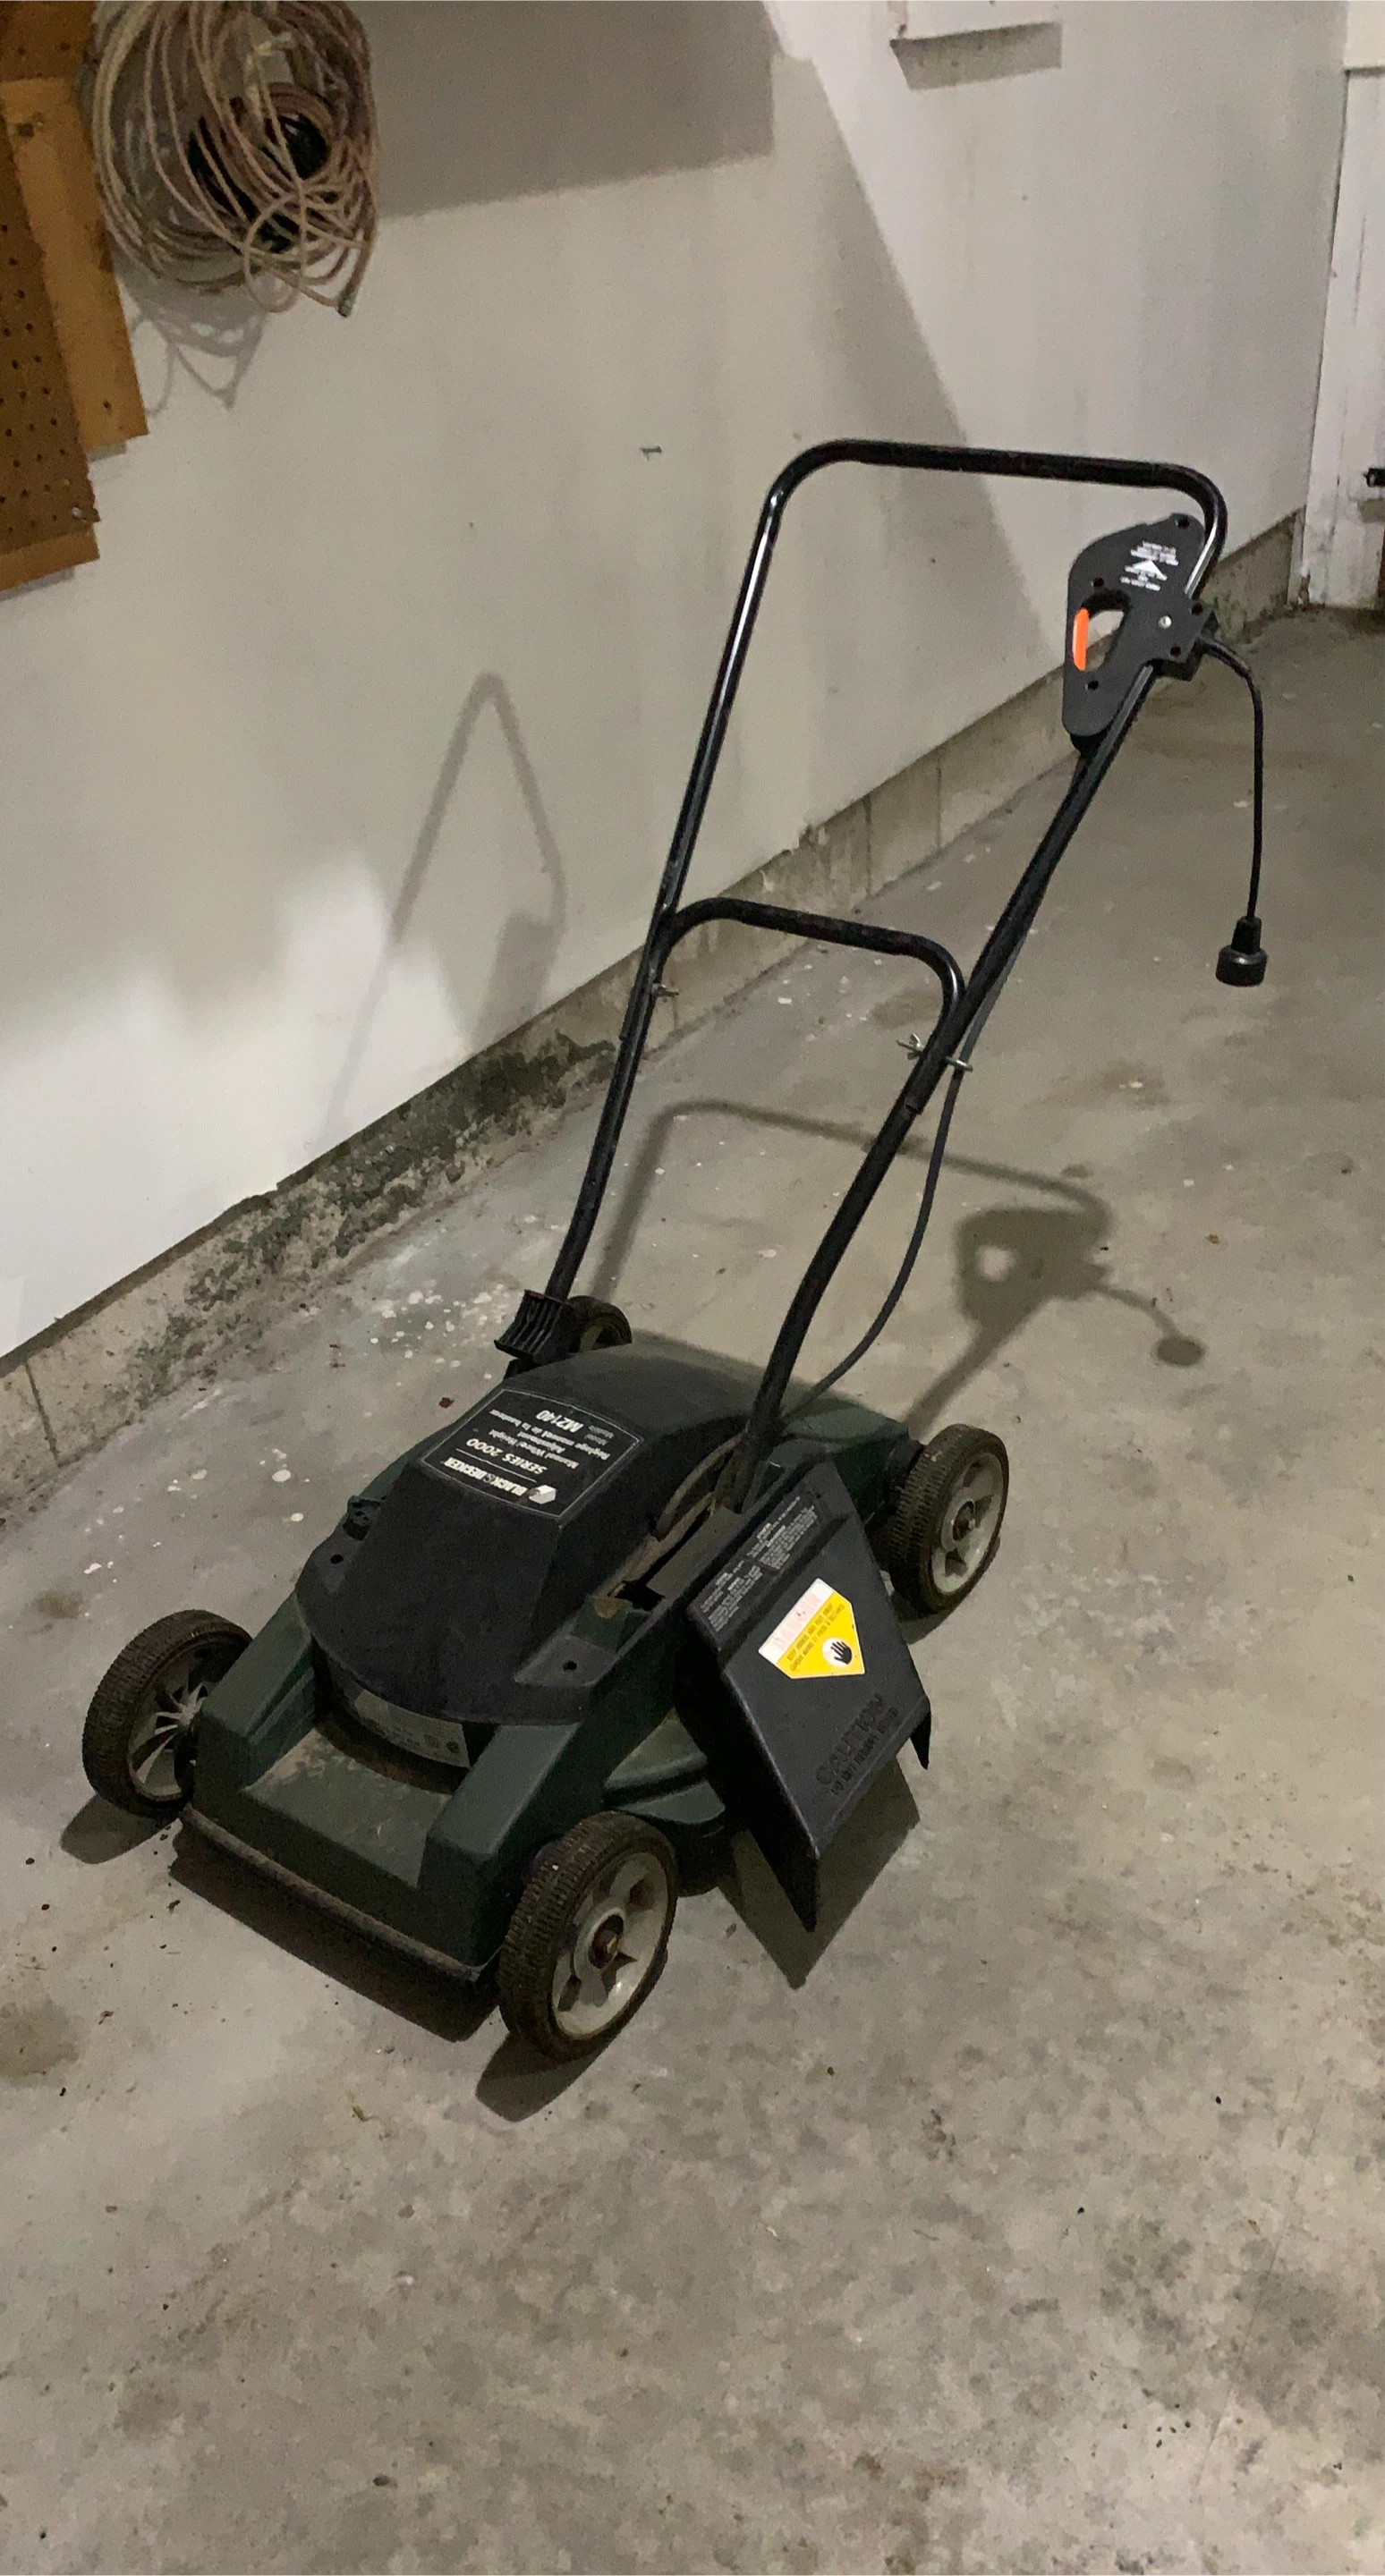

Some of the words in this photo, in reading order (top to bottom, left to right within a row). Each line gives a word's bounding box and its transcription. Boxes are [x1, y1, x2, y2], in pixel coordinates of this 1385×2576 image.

[536, 1410, 583, 1433] M2140
[489, 1429, 517, 1445] Height
[517, 1431, 565, 1453] Adjustment
[466, 1438, 503, 1457] 2000
[517, 1441, 545, 1459] Wheel
[502, 1453, 548, 1474] SERIES
[545, 1452, 579, 1469] Manual
